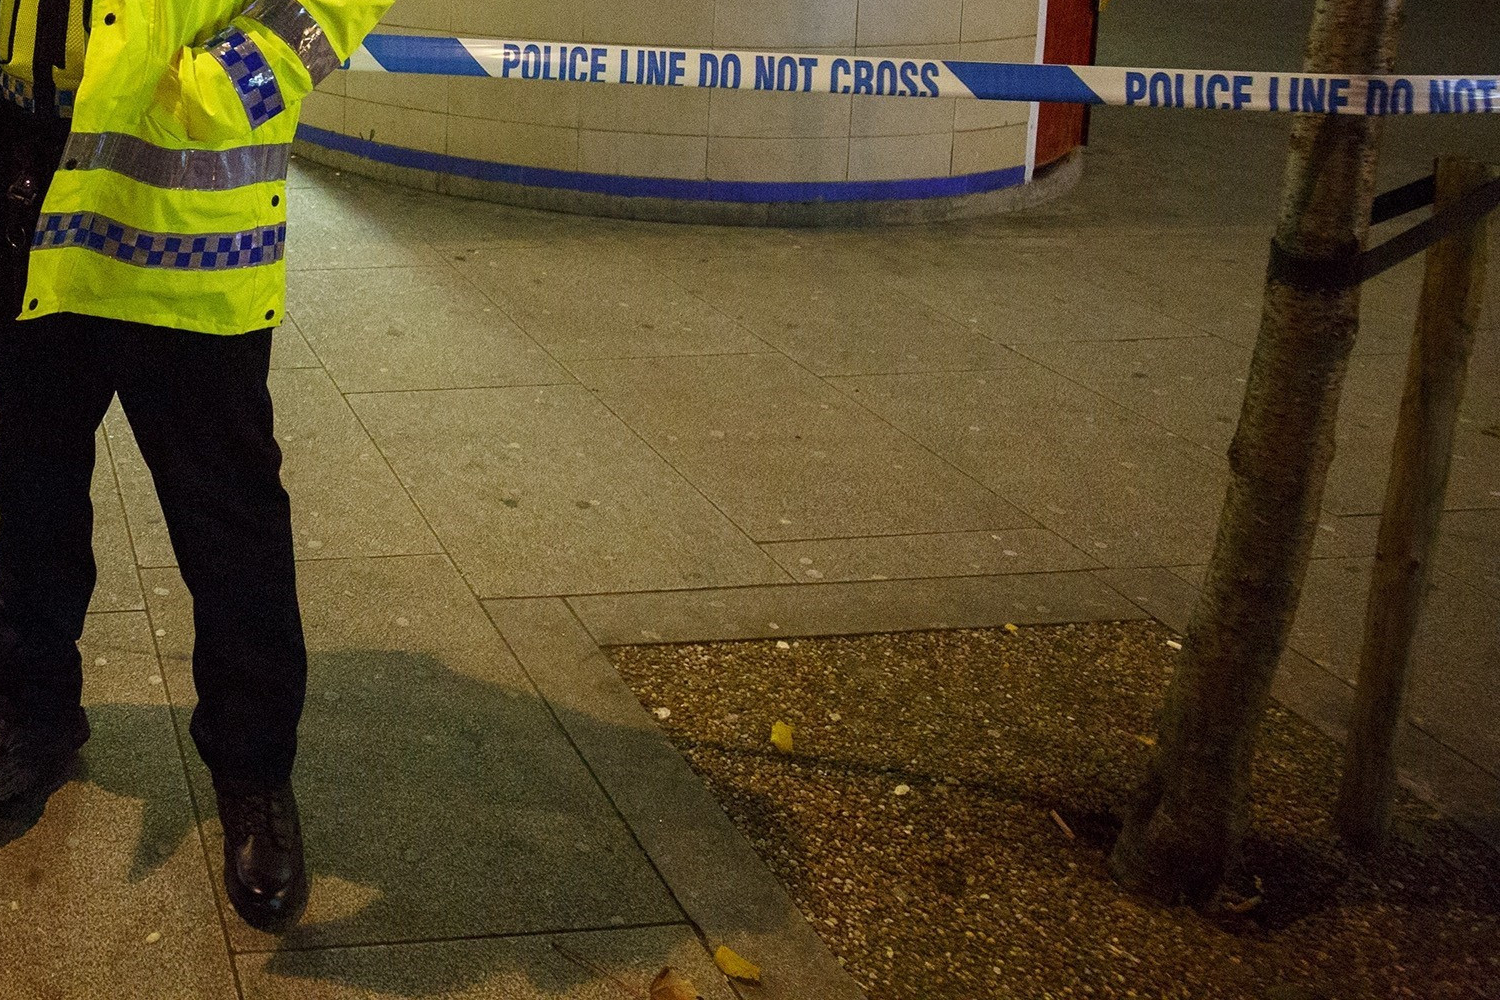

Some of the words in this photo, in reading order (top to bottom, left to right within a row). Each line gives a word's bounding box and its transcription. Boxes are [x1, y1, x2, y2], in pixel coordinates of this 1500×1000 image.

[501, 43, 607, 84] POLICE
[620, 49, 686, 87] LINE
[701, 53, 740, 90] DO
[755, 56, 817, 93] NOT
[830, 58, 939, 99] CROSS
[1125, 71, 1252, 109] POLICE
[1269, 77, 1349, 114] LINE
[1366, 79, 1414, 115] DO
[1430, 79, 1497, 114] NOT
